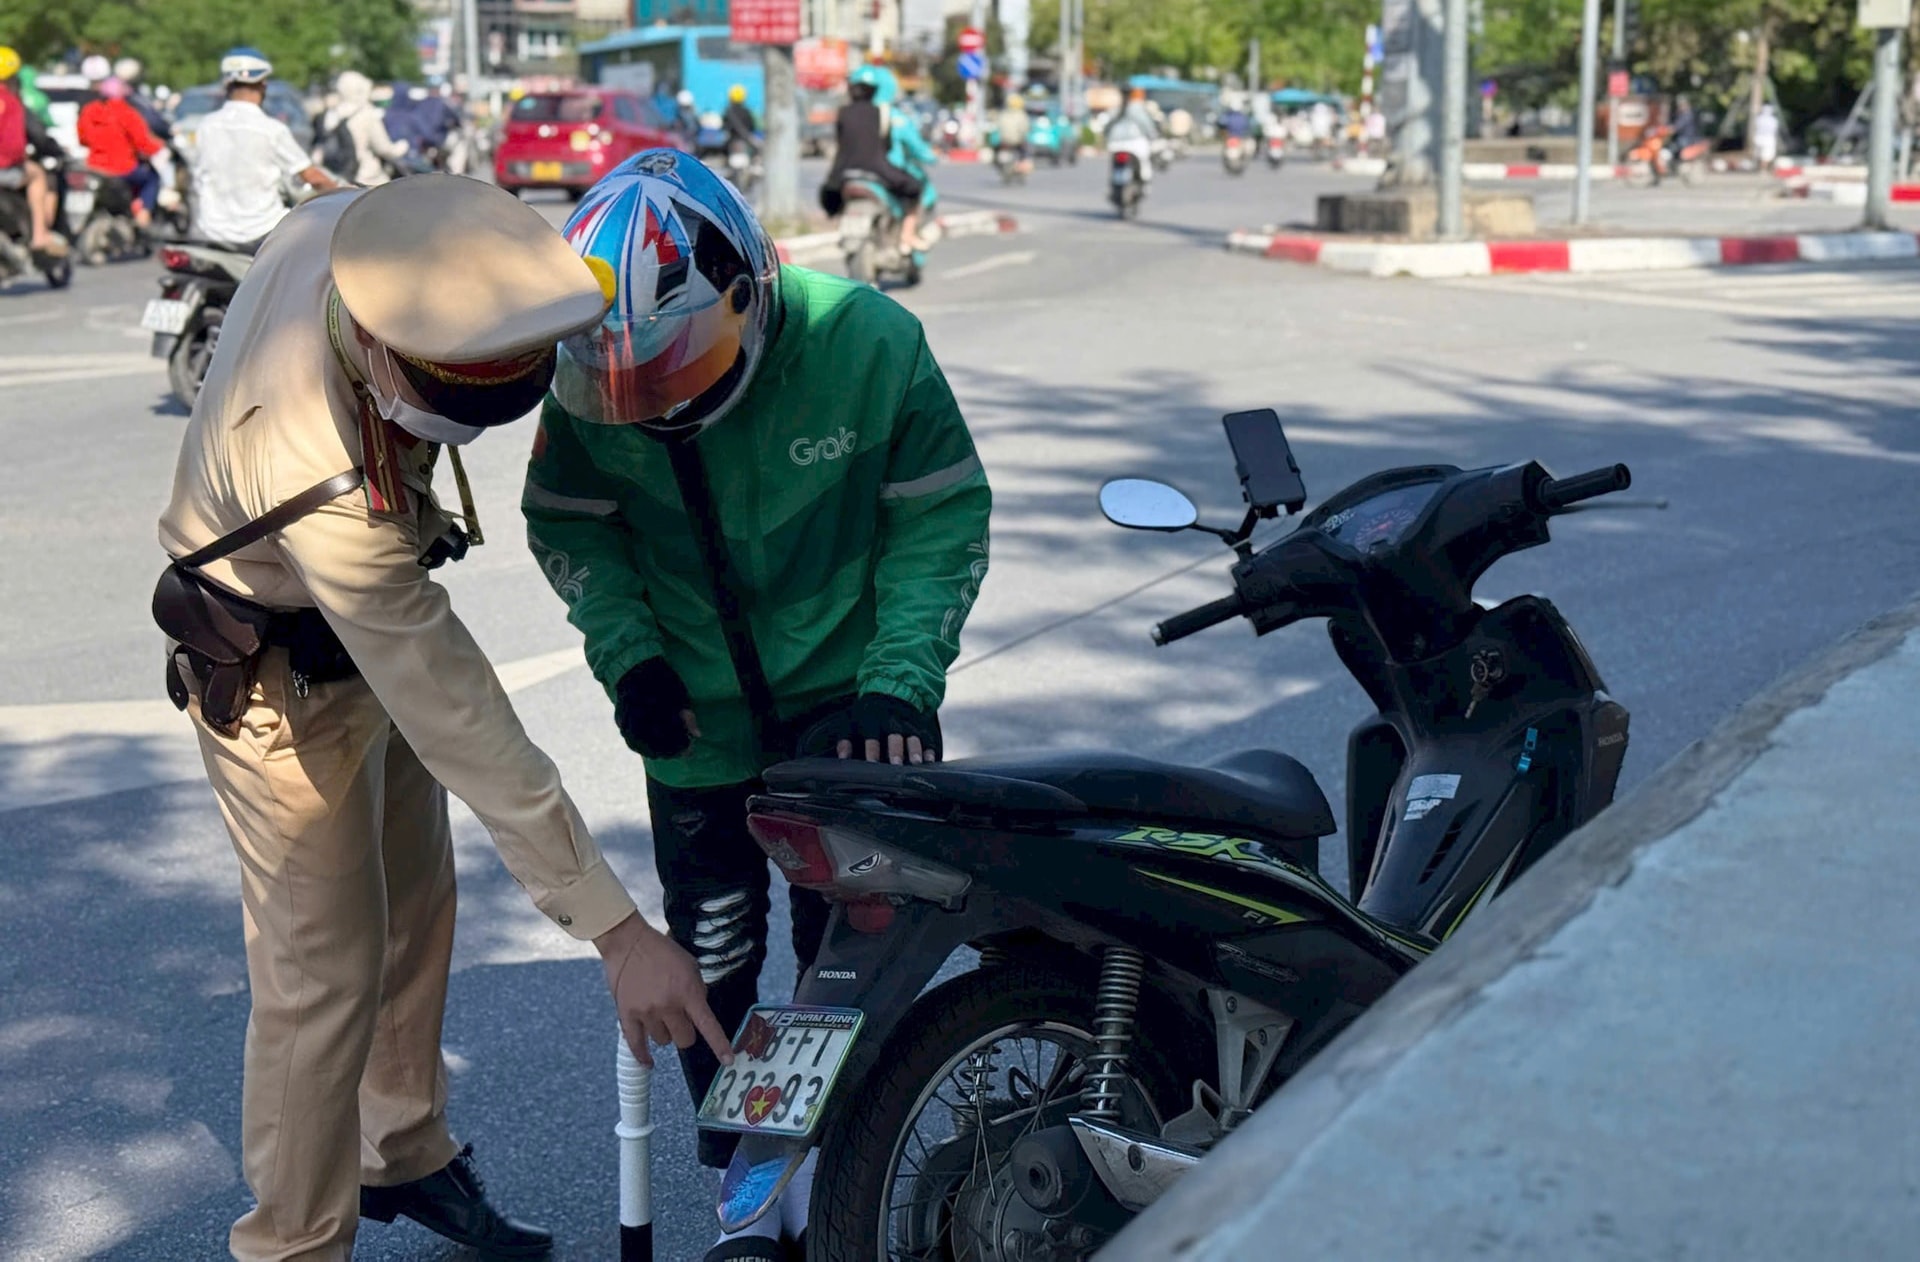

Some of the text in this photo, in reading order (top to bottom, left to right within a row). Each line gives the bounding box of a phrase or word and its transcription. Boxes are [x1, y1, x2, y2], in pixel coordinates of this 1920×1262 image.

[789, 427, 857, 466] Grab
[1114, 826, 1264, 861] RSX
[817, 970, 857, 980] HONDA
